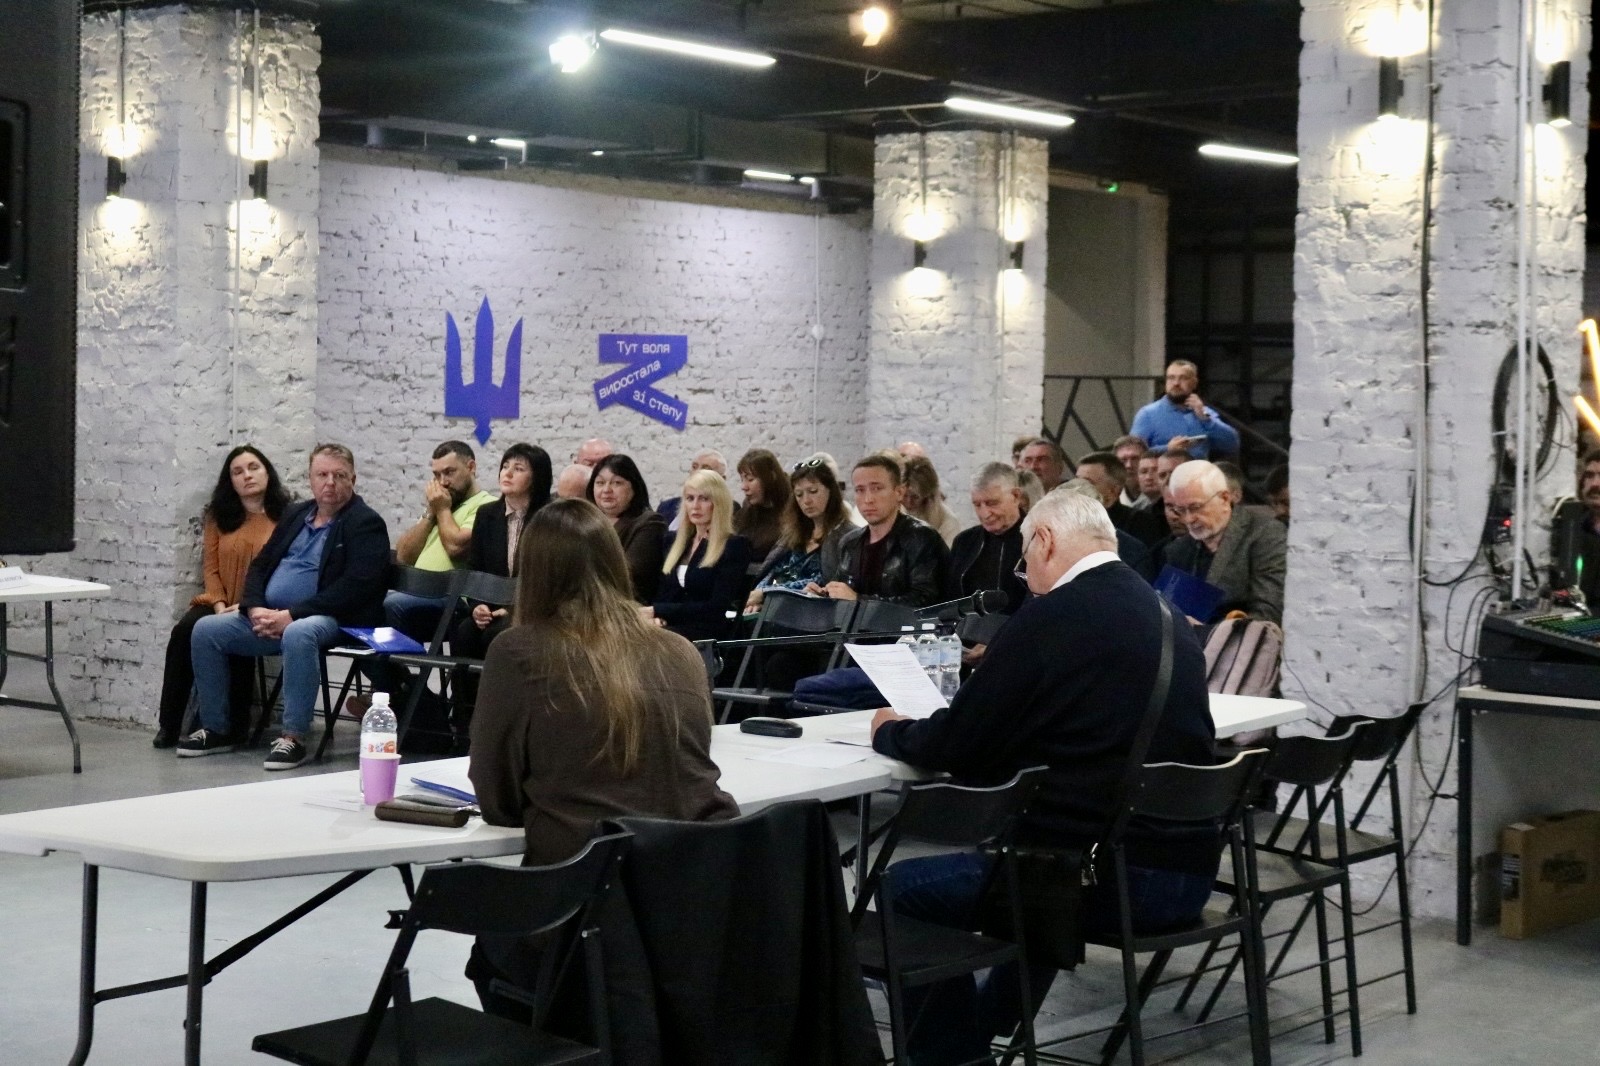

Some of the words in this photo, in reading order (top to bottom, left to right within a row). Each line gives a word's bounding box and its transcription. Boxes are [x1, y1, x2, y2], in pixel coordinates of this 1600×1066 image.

[617, 341, 638, 355] Тут
[642, 343, 670, 354] воля
[599, 360, 661, 399] виростала
[633, 390, 646, 404] зі
[649, 398, 682, 421] степу
